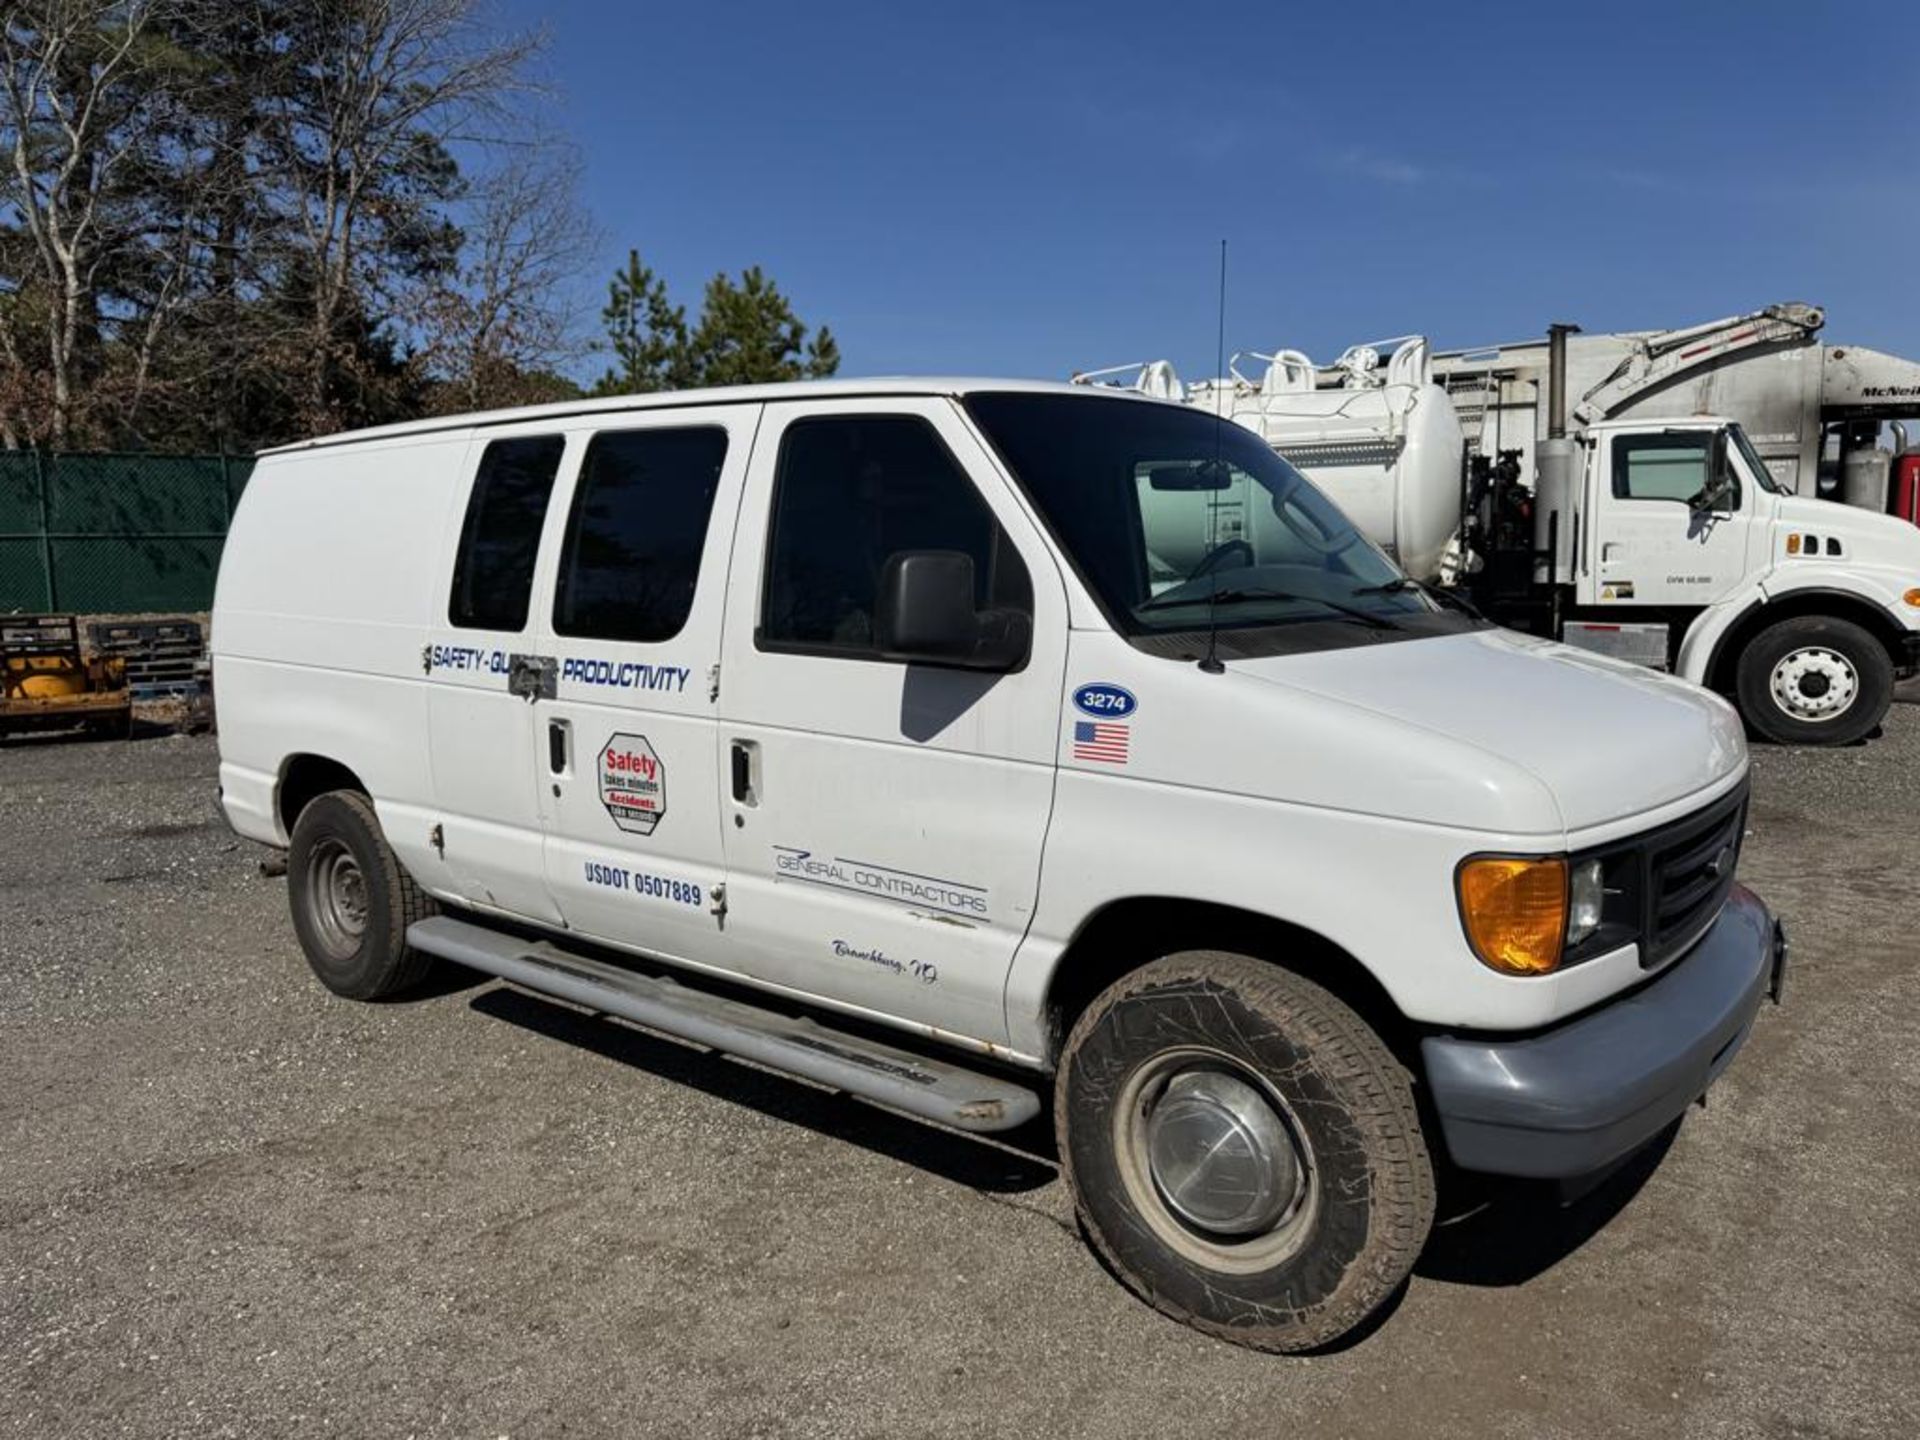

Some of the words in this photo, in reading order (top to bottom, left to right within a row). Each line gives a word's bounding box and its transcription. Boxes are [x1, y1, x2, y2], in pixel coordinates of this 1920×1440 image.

[562, 658, 690, 692] PRODUCTIVITY
[1083, 692, 1126, 710] 3274
[606, 748, 656, 781] Safety
[604, 773, 625, 787] takes
[627, 777, 658, 793] minutes
[608, 792, 656, 809] Accidents
[585, 862, 630, 889] USDOT
[635, 873, 702, 906] 0507889
[776, 854, 849, 882] GENERAL
[854, 871, 988, 912] CONTRACTORS
